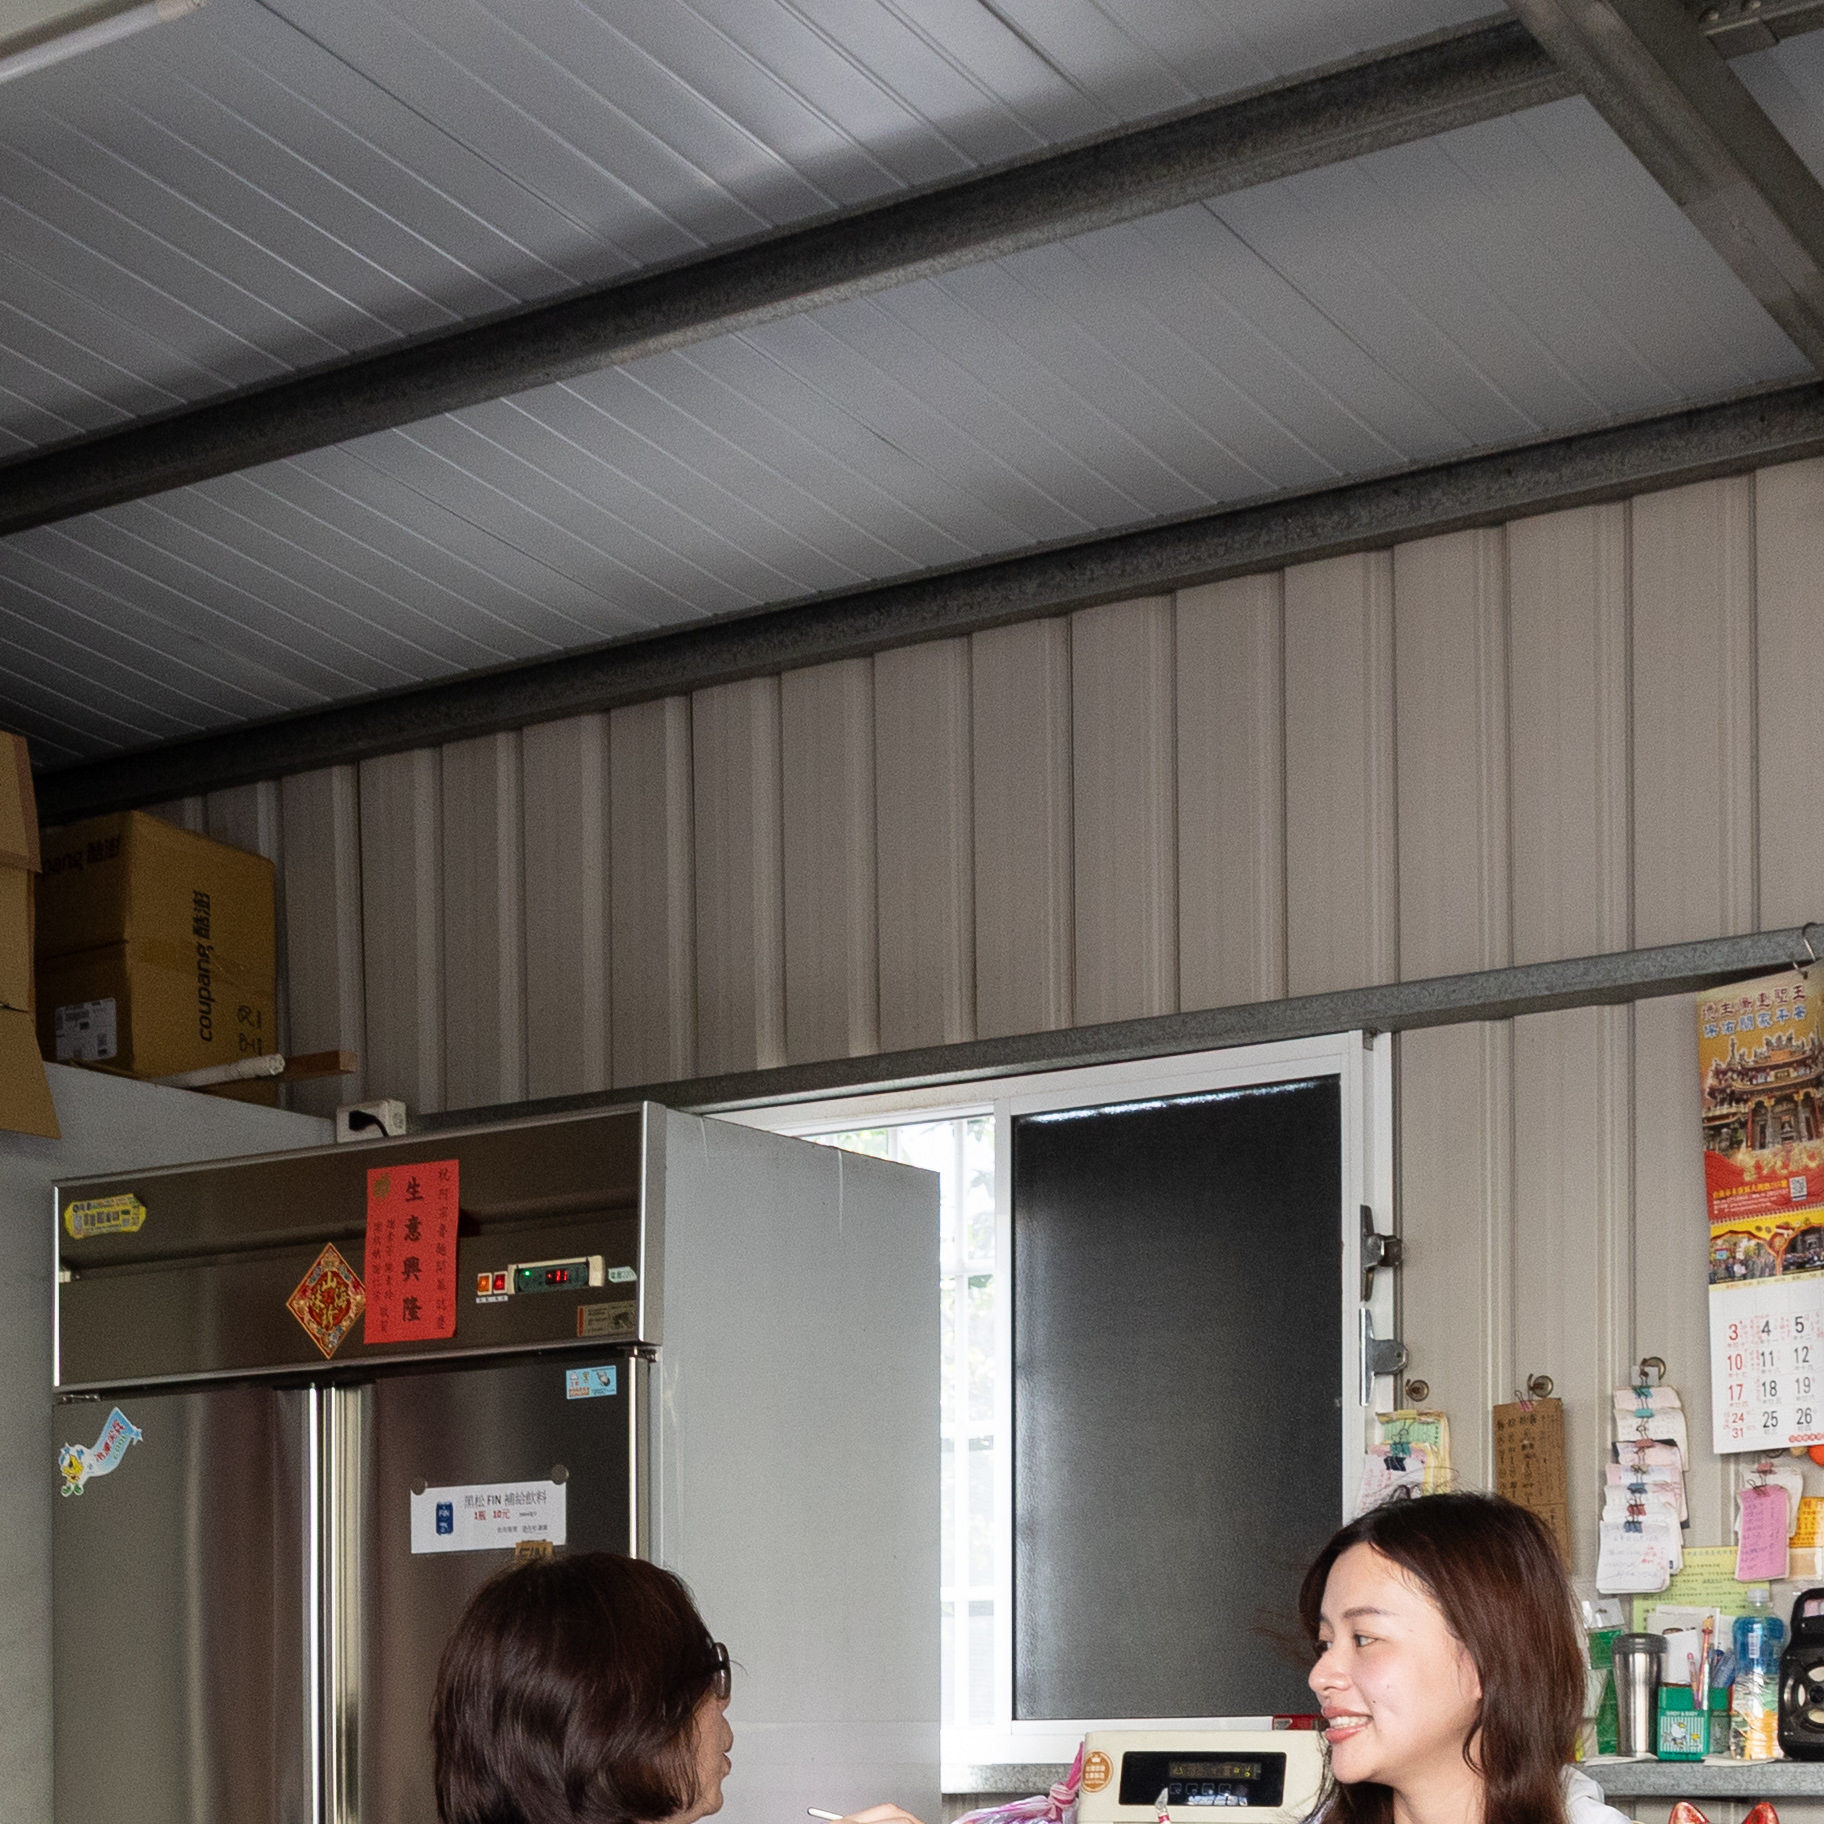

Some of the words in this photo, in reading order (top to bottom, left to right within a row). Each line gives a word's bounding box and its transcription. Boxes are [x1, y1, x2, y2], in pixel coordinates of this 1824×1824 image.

[193, 890, 211, 940] 酷澎
[197, 942, 215, 1043] coupang
[401, 1176, 424, 1322] 生意興隆
[1728, 1323, 1738, 1340] 3
[1761, 1320, 1771, 1336] 4
[1795, 1316, 1804, 1333] 5
[1727, 1353, 1743, 1371] 10
[1761, 1351, 1774, 1367] 11
[1794, 1346, 1809, 1363] 12
[1729, 1384, 1743, 1400] 17
[1762, 1380, 1777, 1397] 18
[1795, 1377, 1811, 1394] 19
[1732, 1413, 1744, 1423] 24
[1763, 1411, 1778, 1428] 25
[1796, 1407, 1812, 1425] 26
[1732, 1428, 1743, 1438] 31
[487, 1495, 502, 1506] FIN
[493, 1508, 510, 1519] 10元
